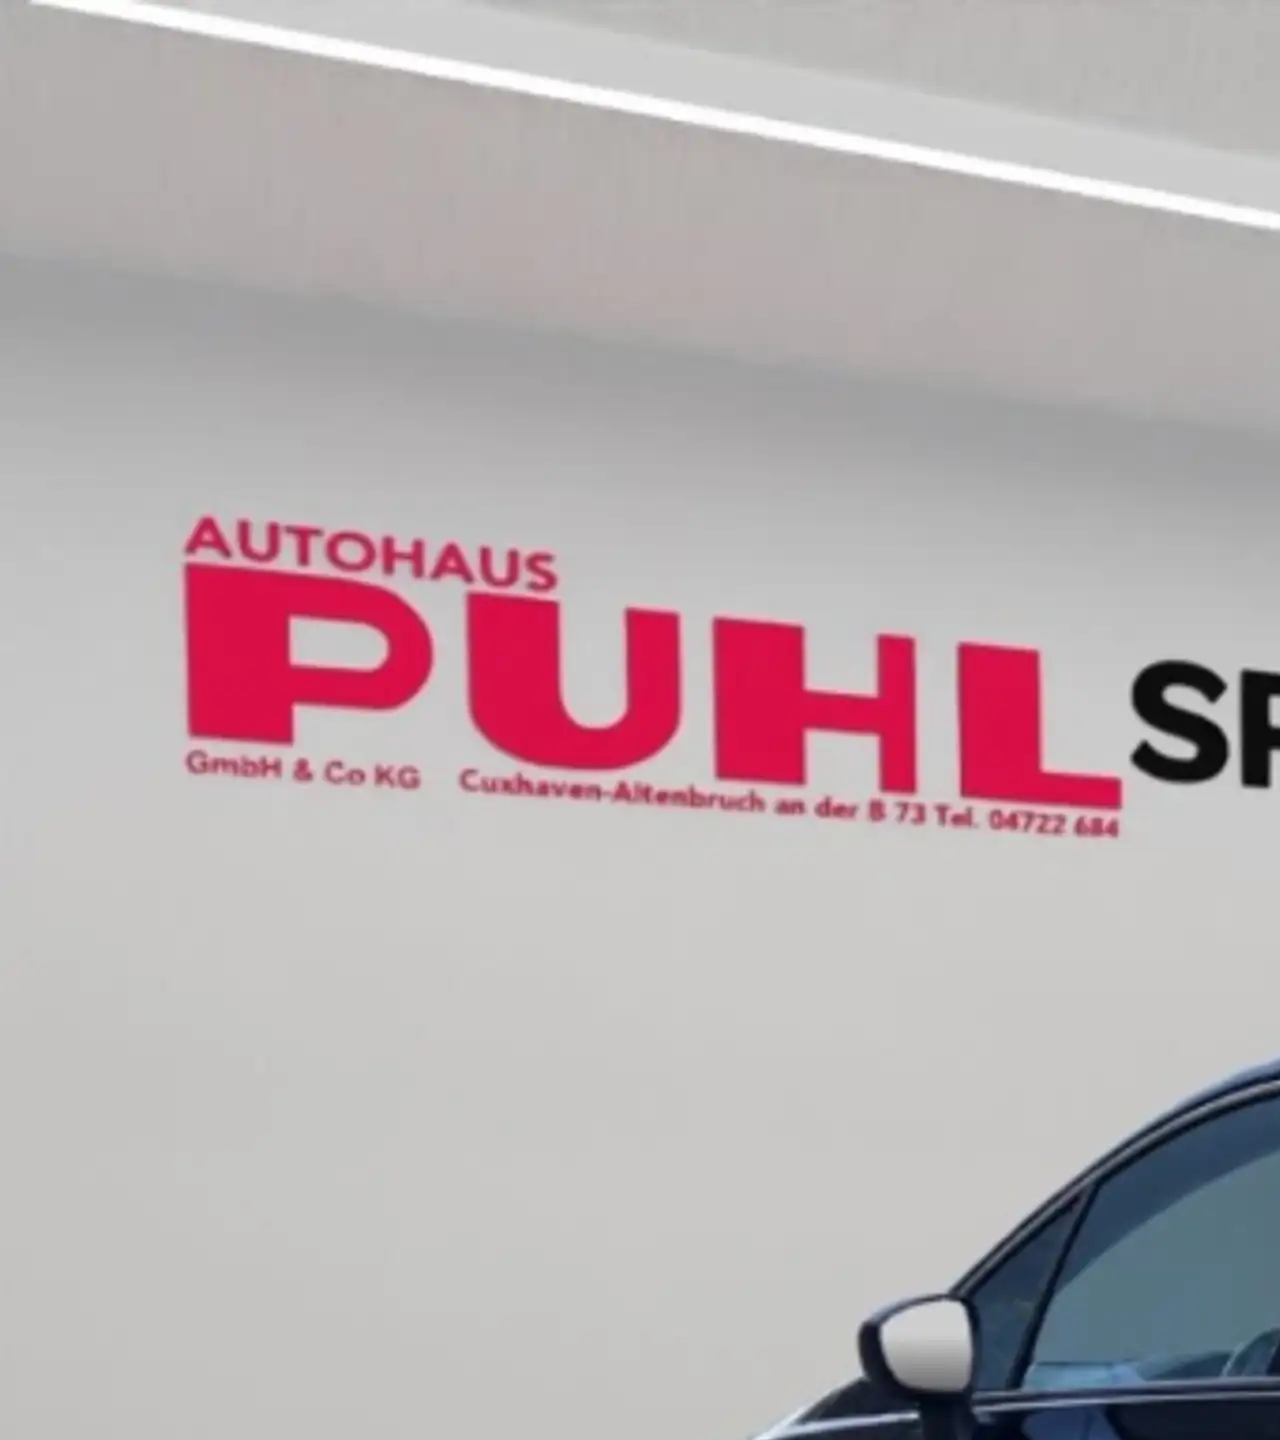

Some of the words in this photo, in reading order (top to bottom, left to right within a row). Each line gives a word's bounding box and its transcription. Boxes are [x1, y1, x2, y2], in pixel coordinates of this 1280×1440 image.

[184, 515, 559, 592] AUTOHAUS
[184, 562, 1123, 811] PUHL
[185, 749, 283, 779] GmbH
[292, 757, 314, 783] &
[324, 760, 367, 786] Co
[374, 763, 421, 790] KG
[458, 768, 767, 815] Cuxhaven-Altenbruch
[774, 798, 806, 817] an
[814, 796, 859, 820] der
[867, 800, 886, 822] B
[895, 801, 927, 826] 73
[934, 804, 979, 829] Tel.
[987, 808, 1067, 837] 04722
[1073, 814, 1120, 839] 684
